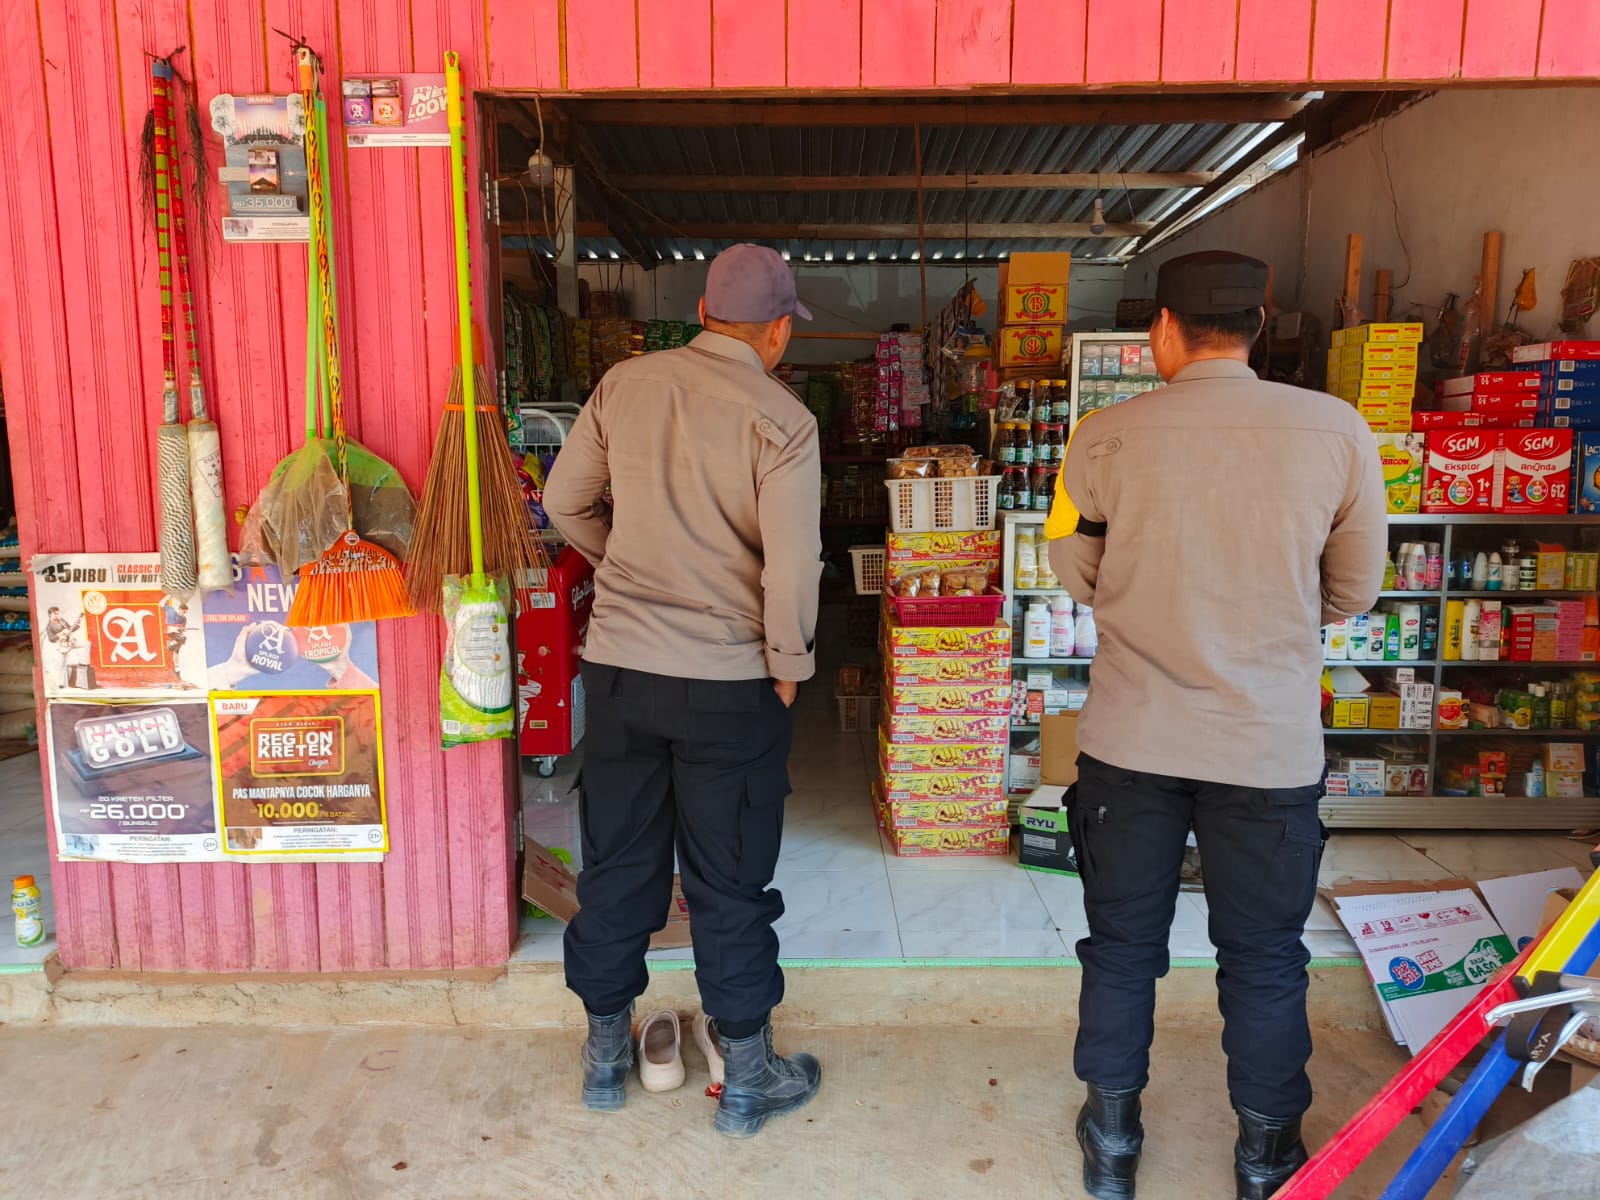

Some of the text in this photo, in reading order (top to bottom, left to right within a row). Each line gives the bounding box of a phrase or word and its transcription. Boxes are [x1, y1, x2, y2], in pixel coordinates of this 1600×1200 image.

[1447, 436, 1480, 453] SGM
[1523, 435, 1555, 452] SGM
[1381, 455, 1410, 465] ancow
[1444, 463, 1481, 472] Eksplor
[1407, 472, 1421, 483] 3+
[1476, 478, 1490, 492] 1+
[72, 568, 107, 583] RIBU
[117, 564, 152, 574] CLASSIC
[303, 645, 342, 659] TROPICAL
[251, 655, 283, 672] ROYAL
[221, 702, 249, 711] BARU
[84, 713, 174, 745] NATION
[88, 729, 179, 763] GOLD
[257, 731, 334, 746] REGION
[257, 744, 334, 759] KRETEK
[232, 783, 371, 800] PAS MANTAPNYA COCOK HARGANYA
[1026, 816, 1056, 829] RYU
[1470, 956, 1486, 965] RASA
[1530, 1032, 1552, 1060] RYA
